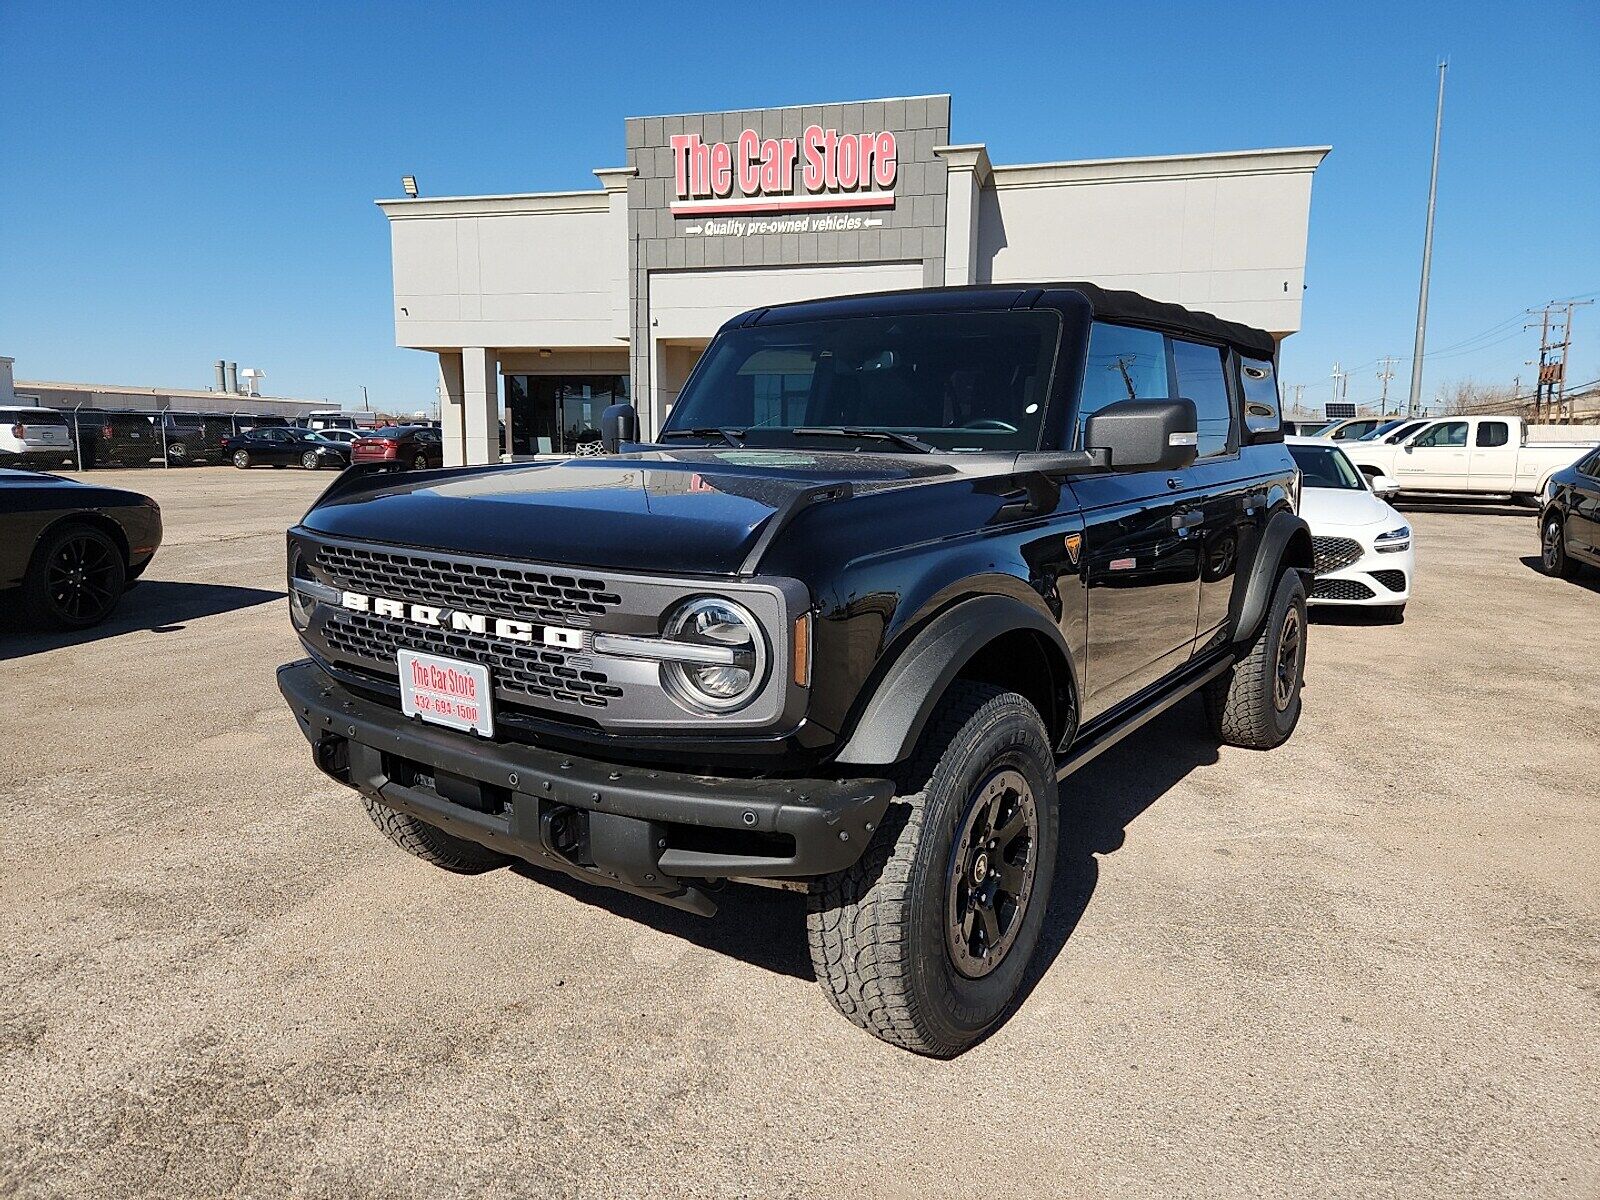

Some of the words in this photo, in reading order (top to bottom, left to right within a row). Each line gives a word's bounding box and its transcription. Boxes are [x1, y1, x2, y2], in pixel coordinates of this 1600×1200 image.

[670, 133, 732, 197] The
[737, 128, 798, 195] Car
[802, 124, 897, 191] Store
[704, 220, 745, 238] Quality
[747, 217, 809, 237] pre-owned
[812, 215, 862, 231] vehicles
[342, 591, 584, 650] BRONCO
[411, 658, 430, 687] The
[430, 664, 447, 691] Car
[447, 668, 476, 698] Store
